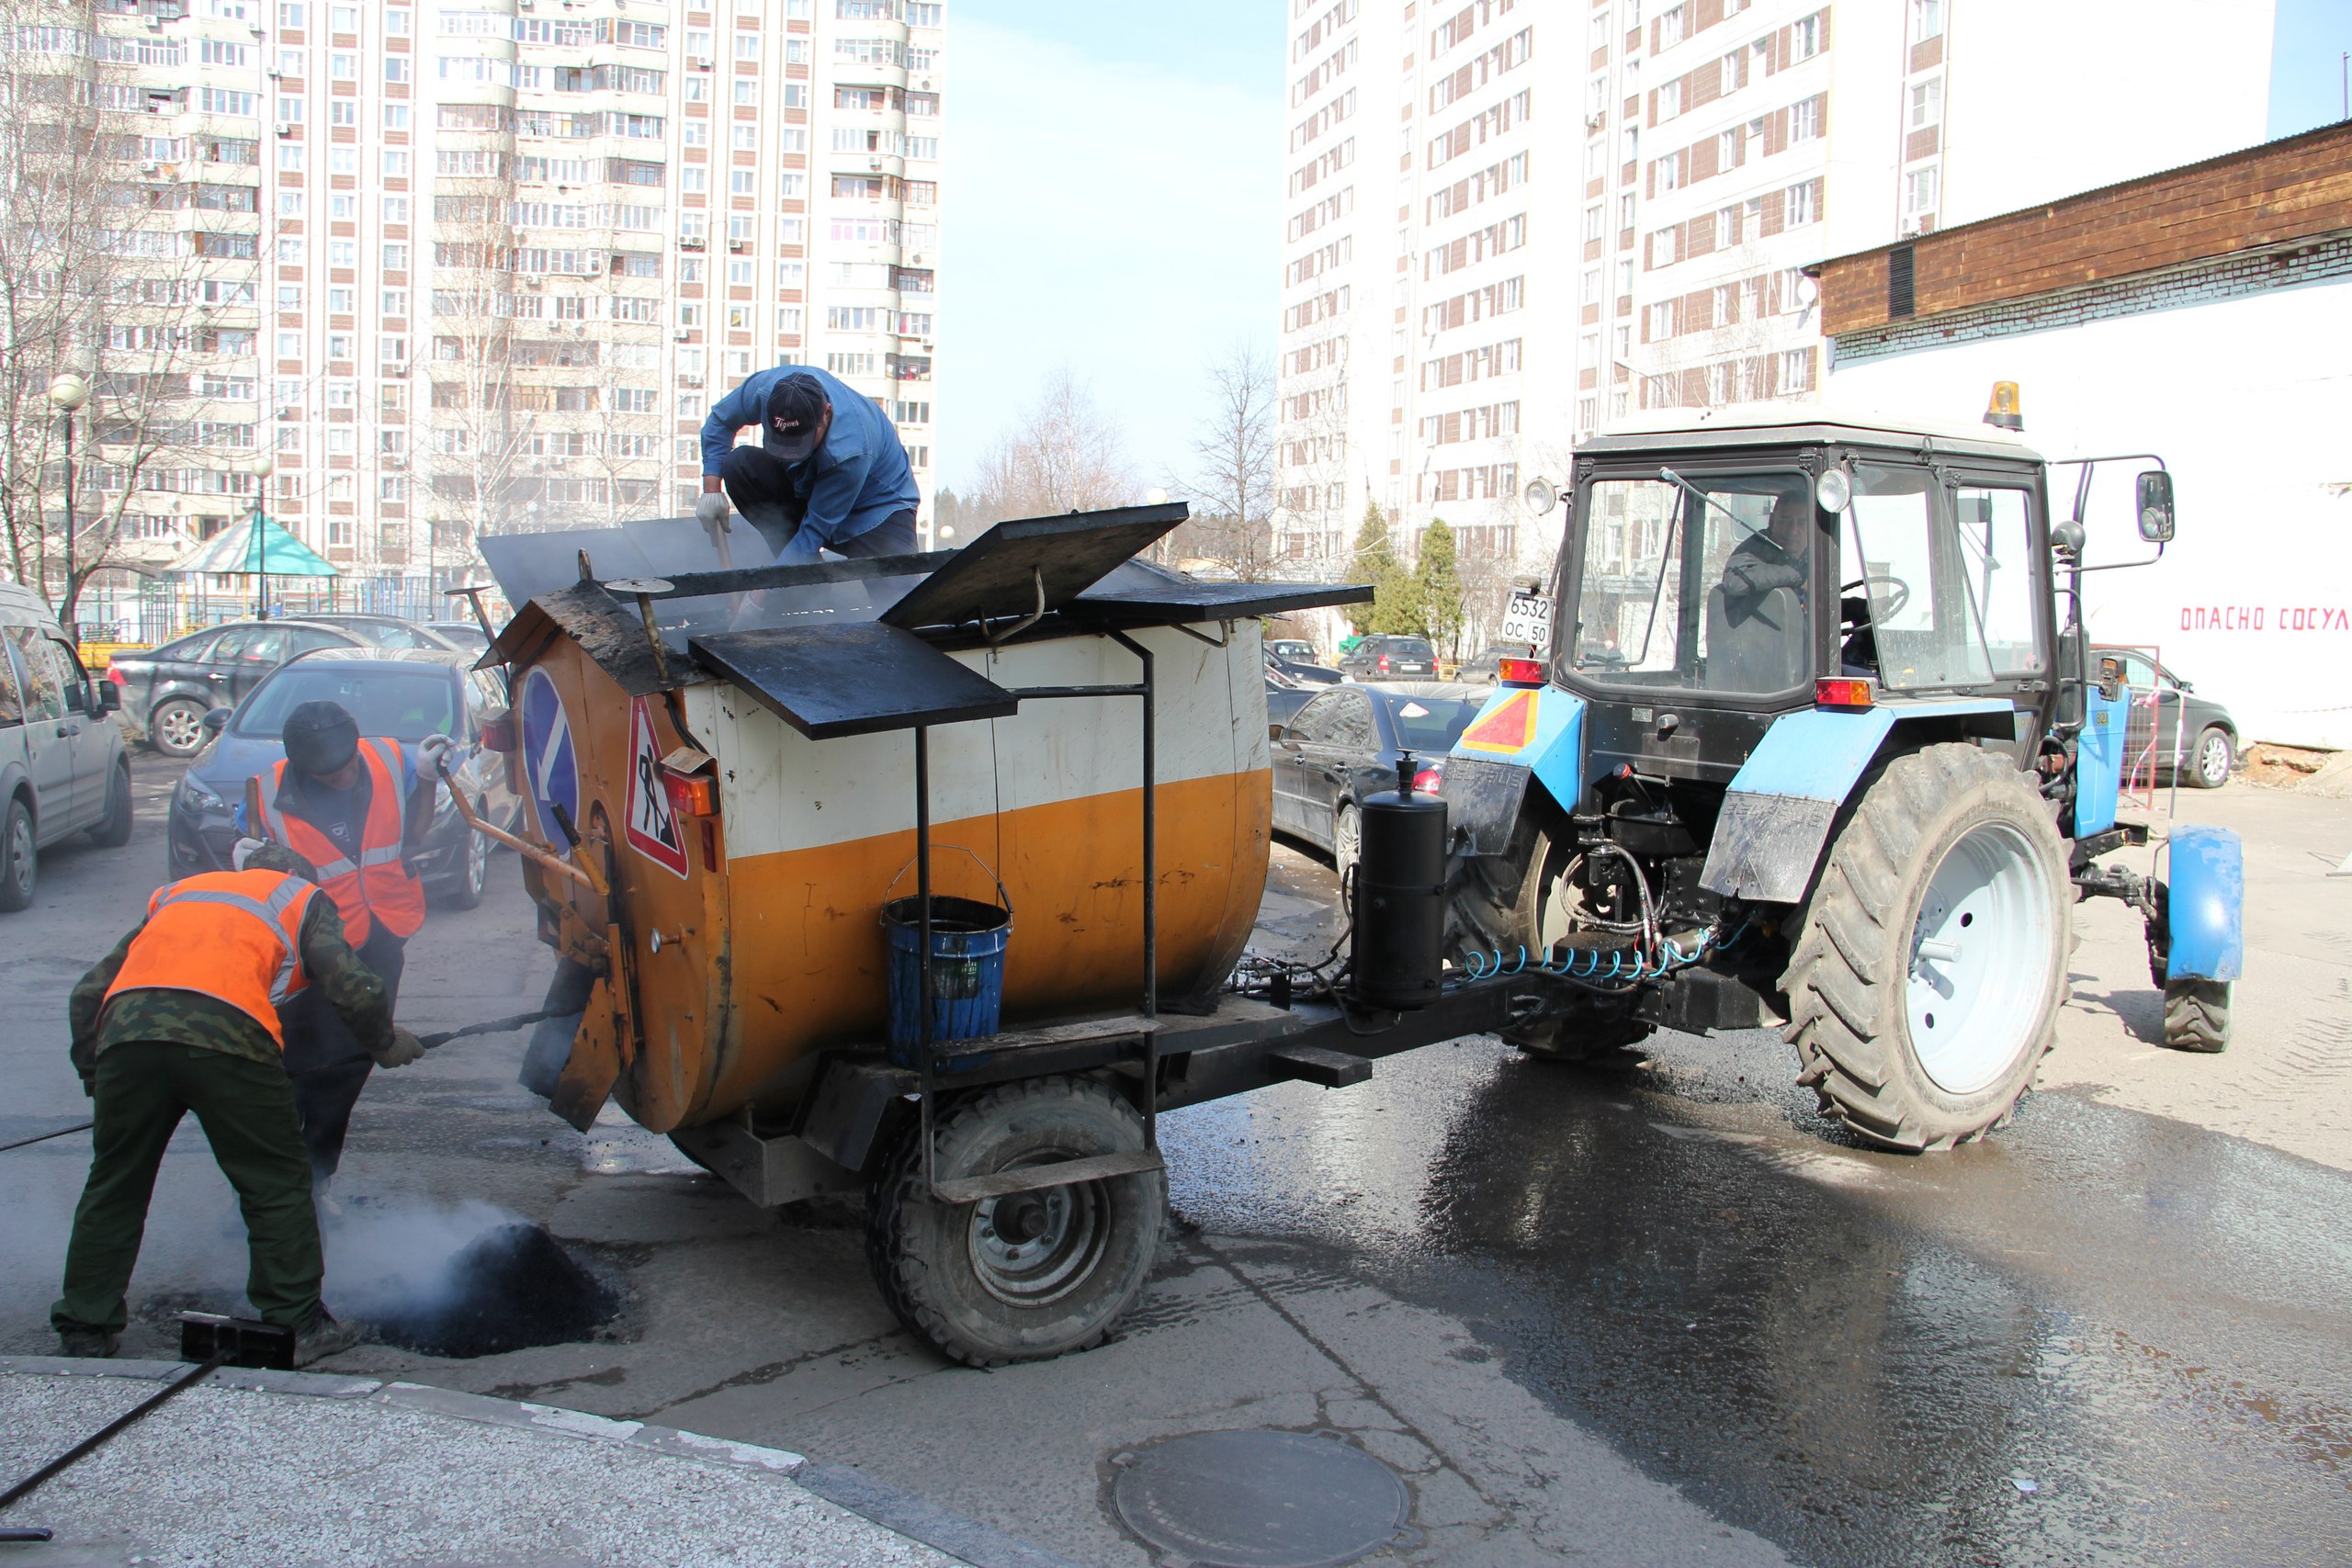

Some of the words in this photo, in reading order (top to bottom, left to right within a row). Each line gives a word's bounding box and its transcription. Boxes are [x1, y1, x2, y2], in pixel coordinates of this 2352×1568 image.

[774, 415, 799, 432] Tigers
[1510, 596, 1547, 619] 6532
[2180, 606, 2265, 631] ОПАСНО
[1531, 626, 1546, 642] 50
